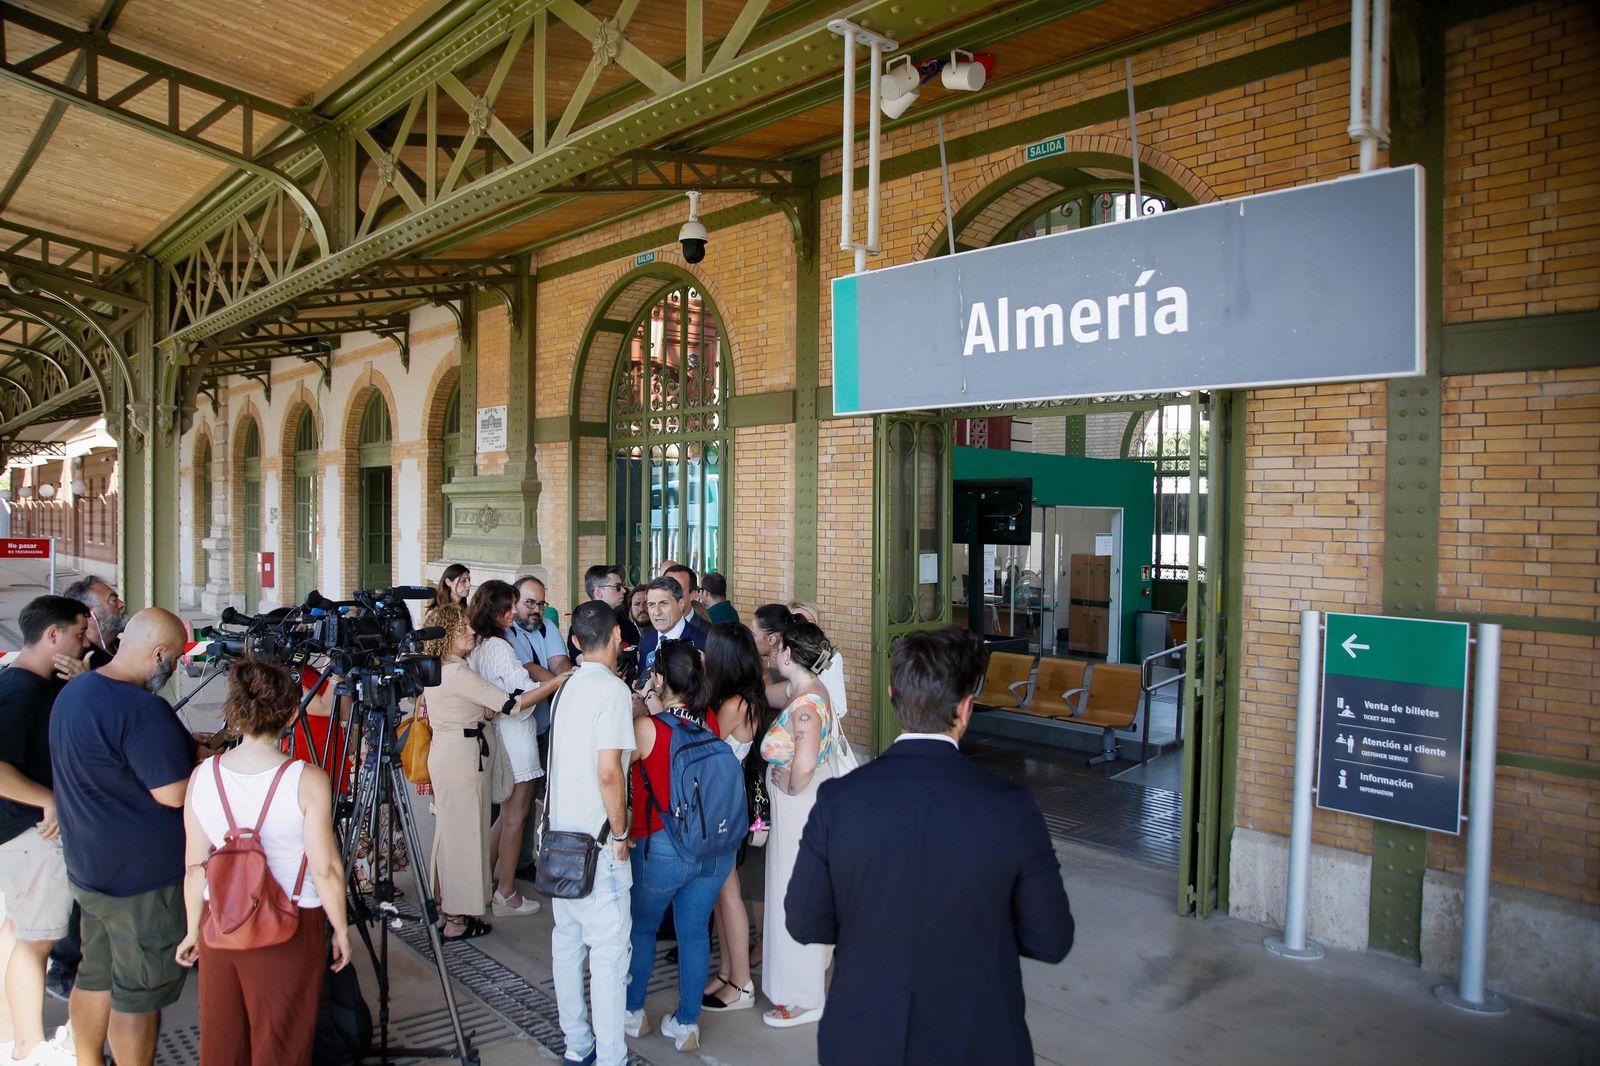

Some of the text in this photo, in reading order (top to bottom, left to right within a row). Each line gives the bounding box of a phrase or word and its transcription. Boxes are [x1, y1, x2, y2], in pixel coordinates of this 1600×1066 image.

[1030, 140, 1062, 157] SALIDA
[963, 269, 1190, 357] Almería
[1364, 700, 1440, 718] Venta de billetes
[1363, 714, 1396, 724] TICKET SALES
[1362, 736, 1447, 757] Atención al cliente
[1361, 750, 1409, 763] CUSTOMER SERVICE
[1360, 772, 1414, 790] Información
[1359, 786, 1394, 797] INFORMATION
